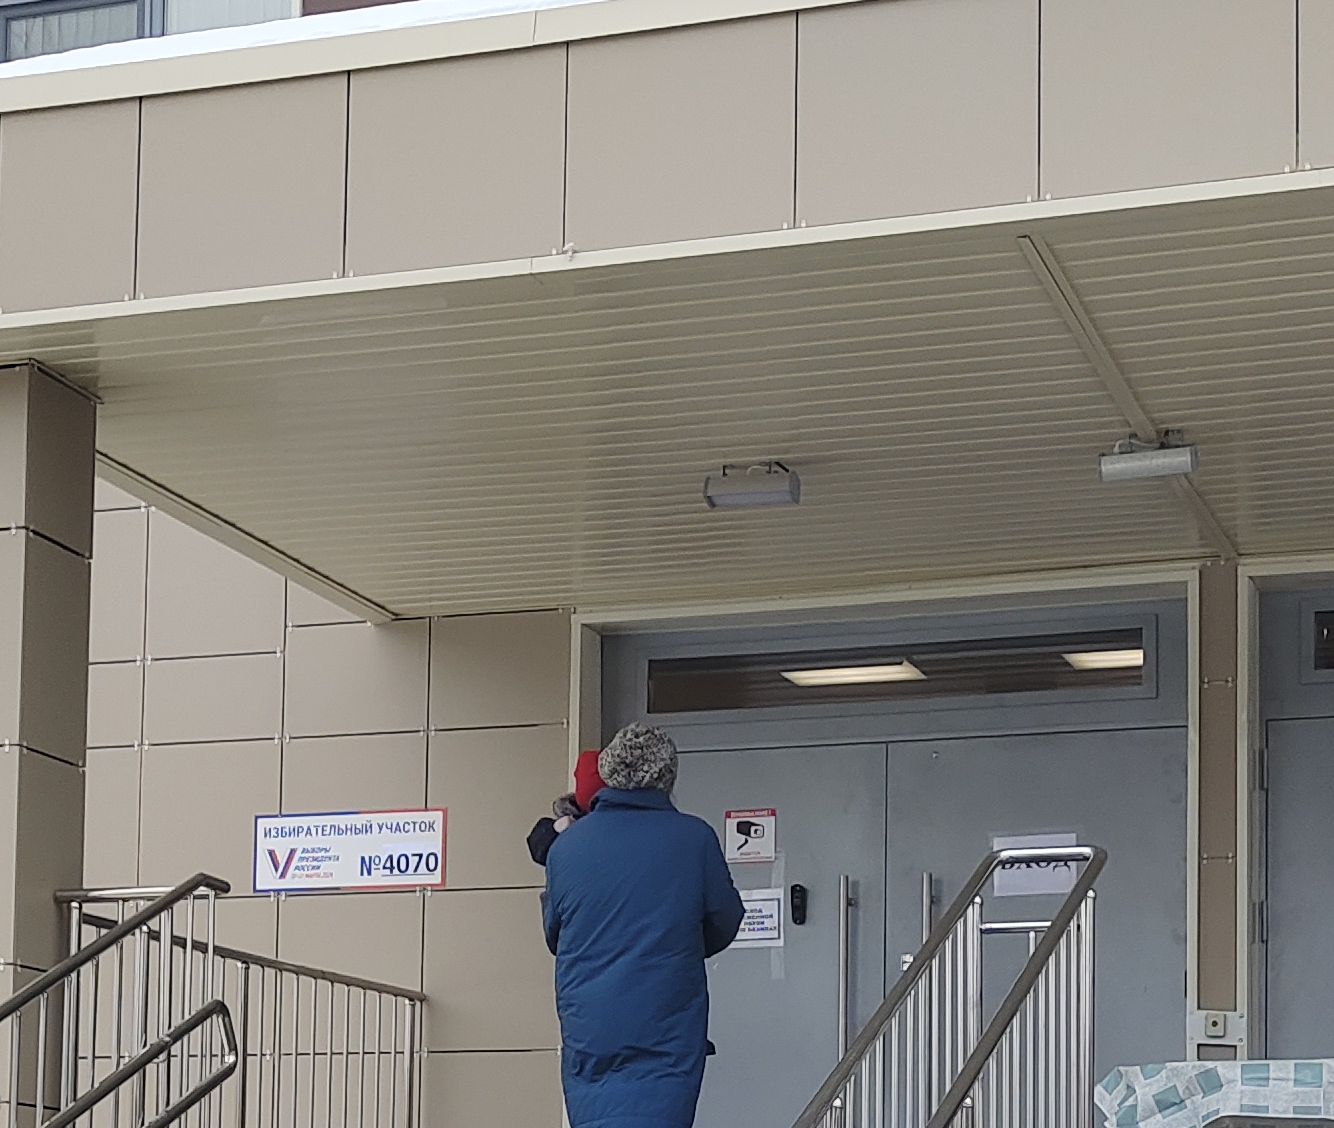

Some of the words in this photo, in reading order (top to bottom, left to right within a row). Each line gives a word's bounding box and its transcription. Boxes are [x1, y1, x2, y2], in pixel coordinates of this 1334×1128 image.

[264, 820, 373, 839] ИЗБИРАТЕЛЬНЫЙ
[377, 820, 436, 834] УЧАСТОК
[360, 852, 439, 877] №4070
